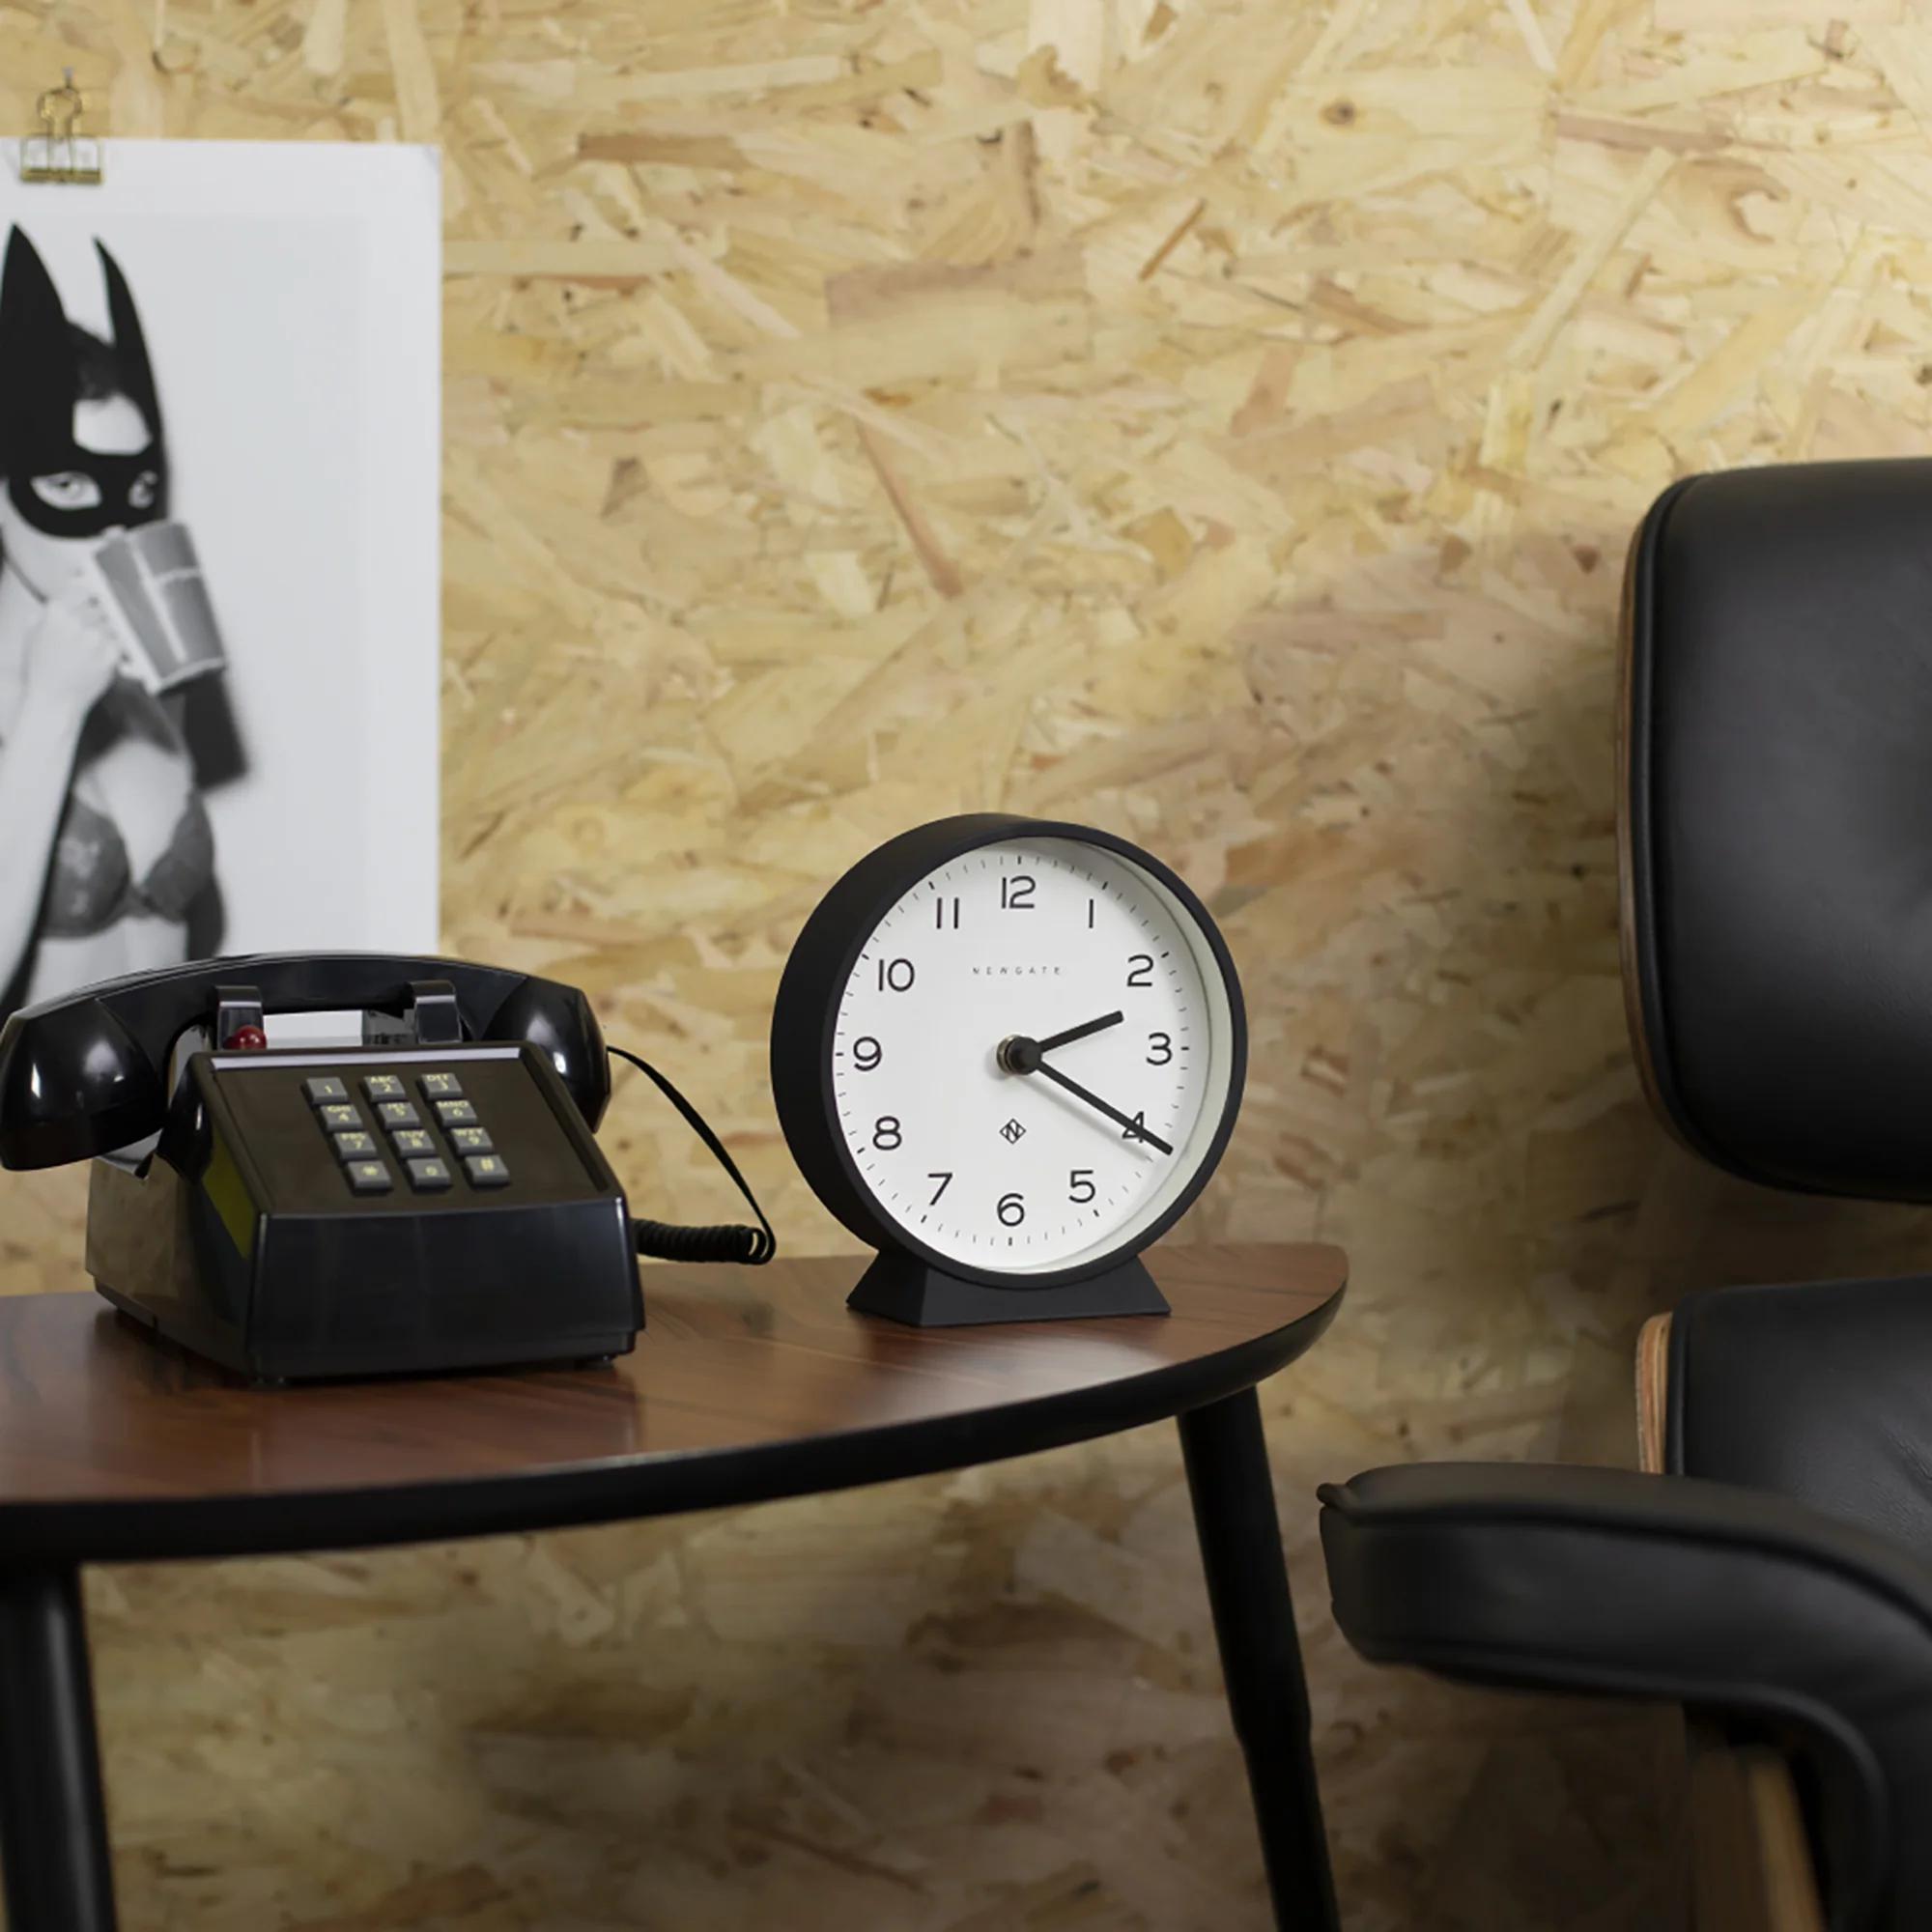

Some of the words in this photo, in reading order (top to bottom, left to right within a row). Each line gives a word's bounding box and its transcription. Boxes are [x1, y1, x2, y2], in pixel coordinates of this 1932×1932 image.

[1001, 875, 1037, 909] 12
[936, 897, 959, 929] 11
[1089, 898, 1094, 929] 1
[878, 958, 915, 992] 10
[972, 966, 1062, 976] NEWGATE
[1126, 954, 1154, 987] 2
[852, 1037, 882, 1072] 9
[1146, 1032, 1173, 1066] 3
[872, 1116, 902, 1151] 8
[1122, 1111, 1144, 1144] 4
[927, 1172, 953, 1206] 7
[1068, 1170, 1096, 1204] 5
[997, 1193, 1025, 1227] 6
